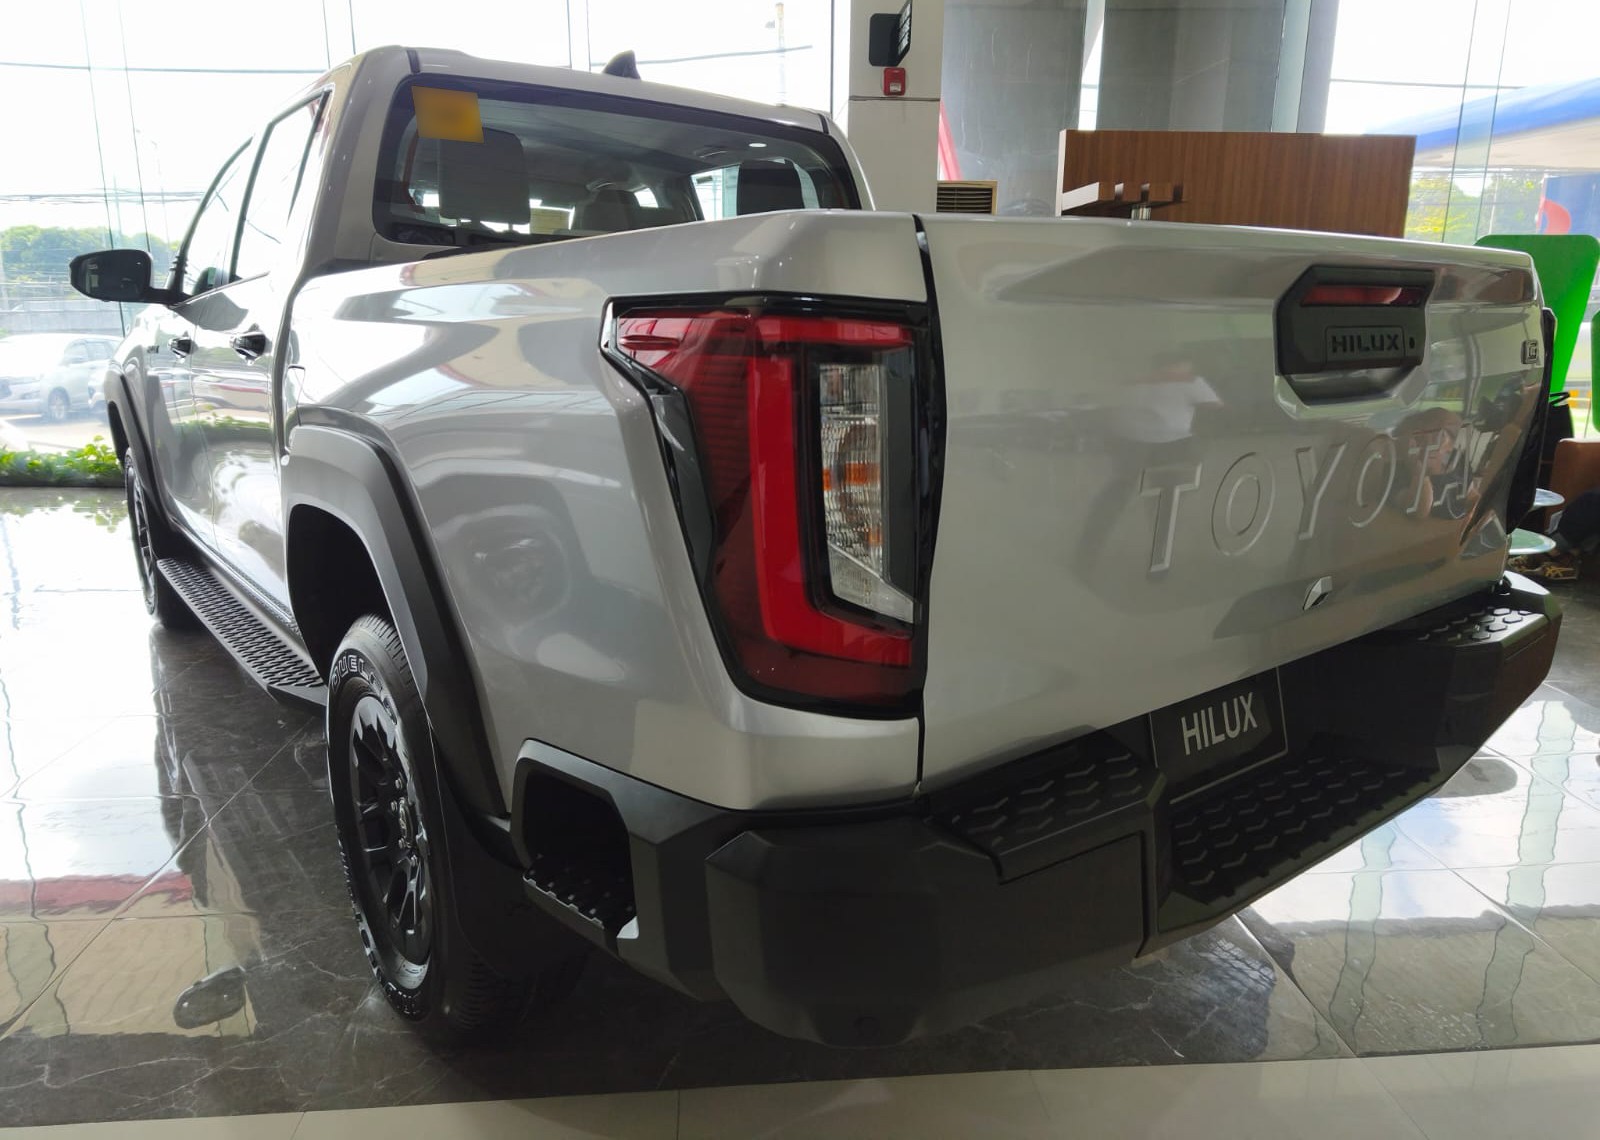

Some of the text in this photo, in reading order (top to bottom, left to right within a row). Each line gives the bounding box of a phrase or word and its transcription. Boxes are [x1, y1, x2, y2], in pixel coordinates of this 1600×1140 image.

[1331, 334, 1399, 353] HILUX
[1139, 425, 1471, 573] TOYOTA
[1181, 692, 1258, 756] HILUX
